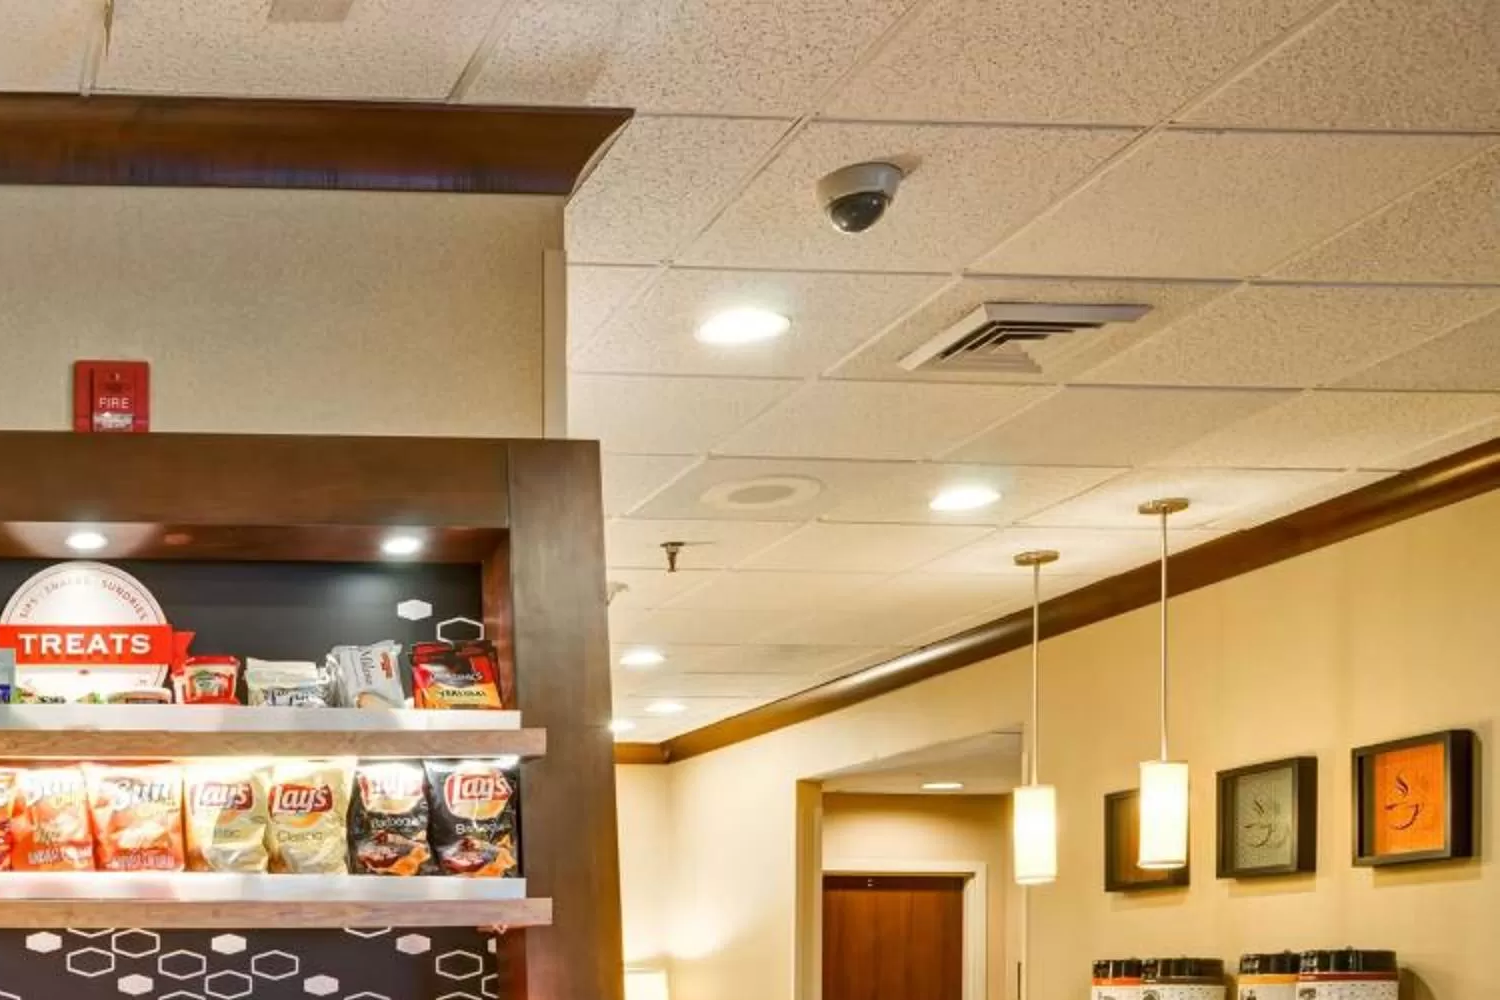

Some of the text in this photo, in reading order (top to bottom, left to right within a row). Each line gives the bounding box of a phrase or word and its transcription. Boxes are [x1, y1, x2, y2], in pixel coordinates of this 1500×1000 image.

[98, 397, 130, 409] FIRE
[16, 631, 153, 656] TREATS
[271, 784, 329, 814] Lay's
[450, 773, 511, 804] Lay's
